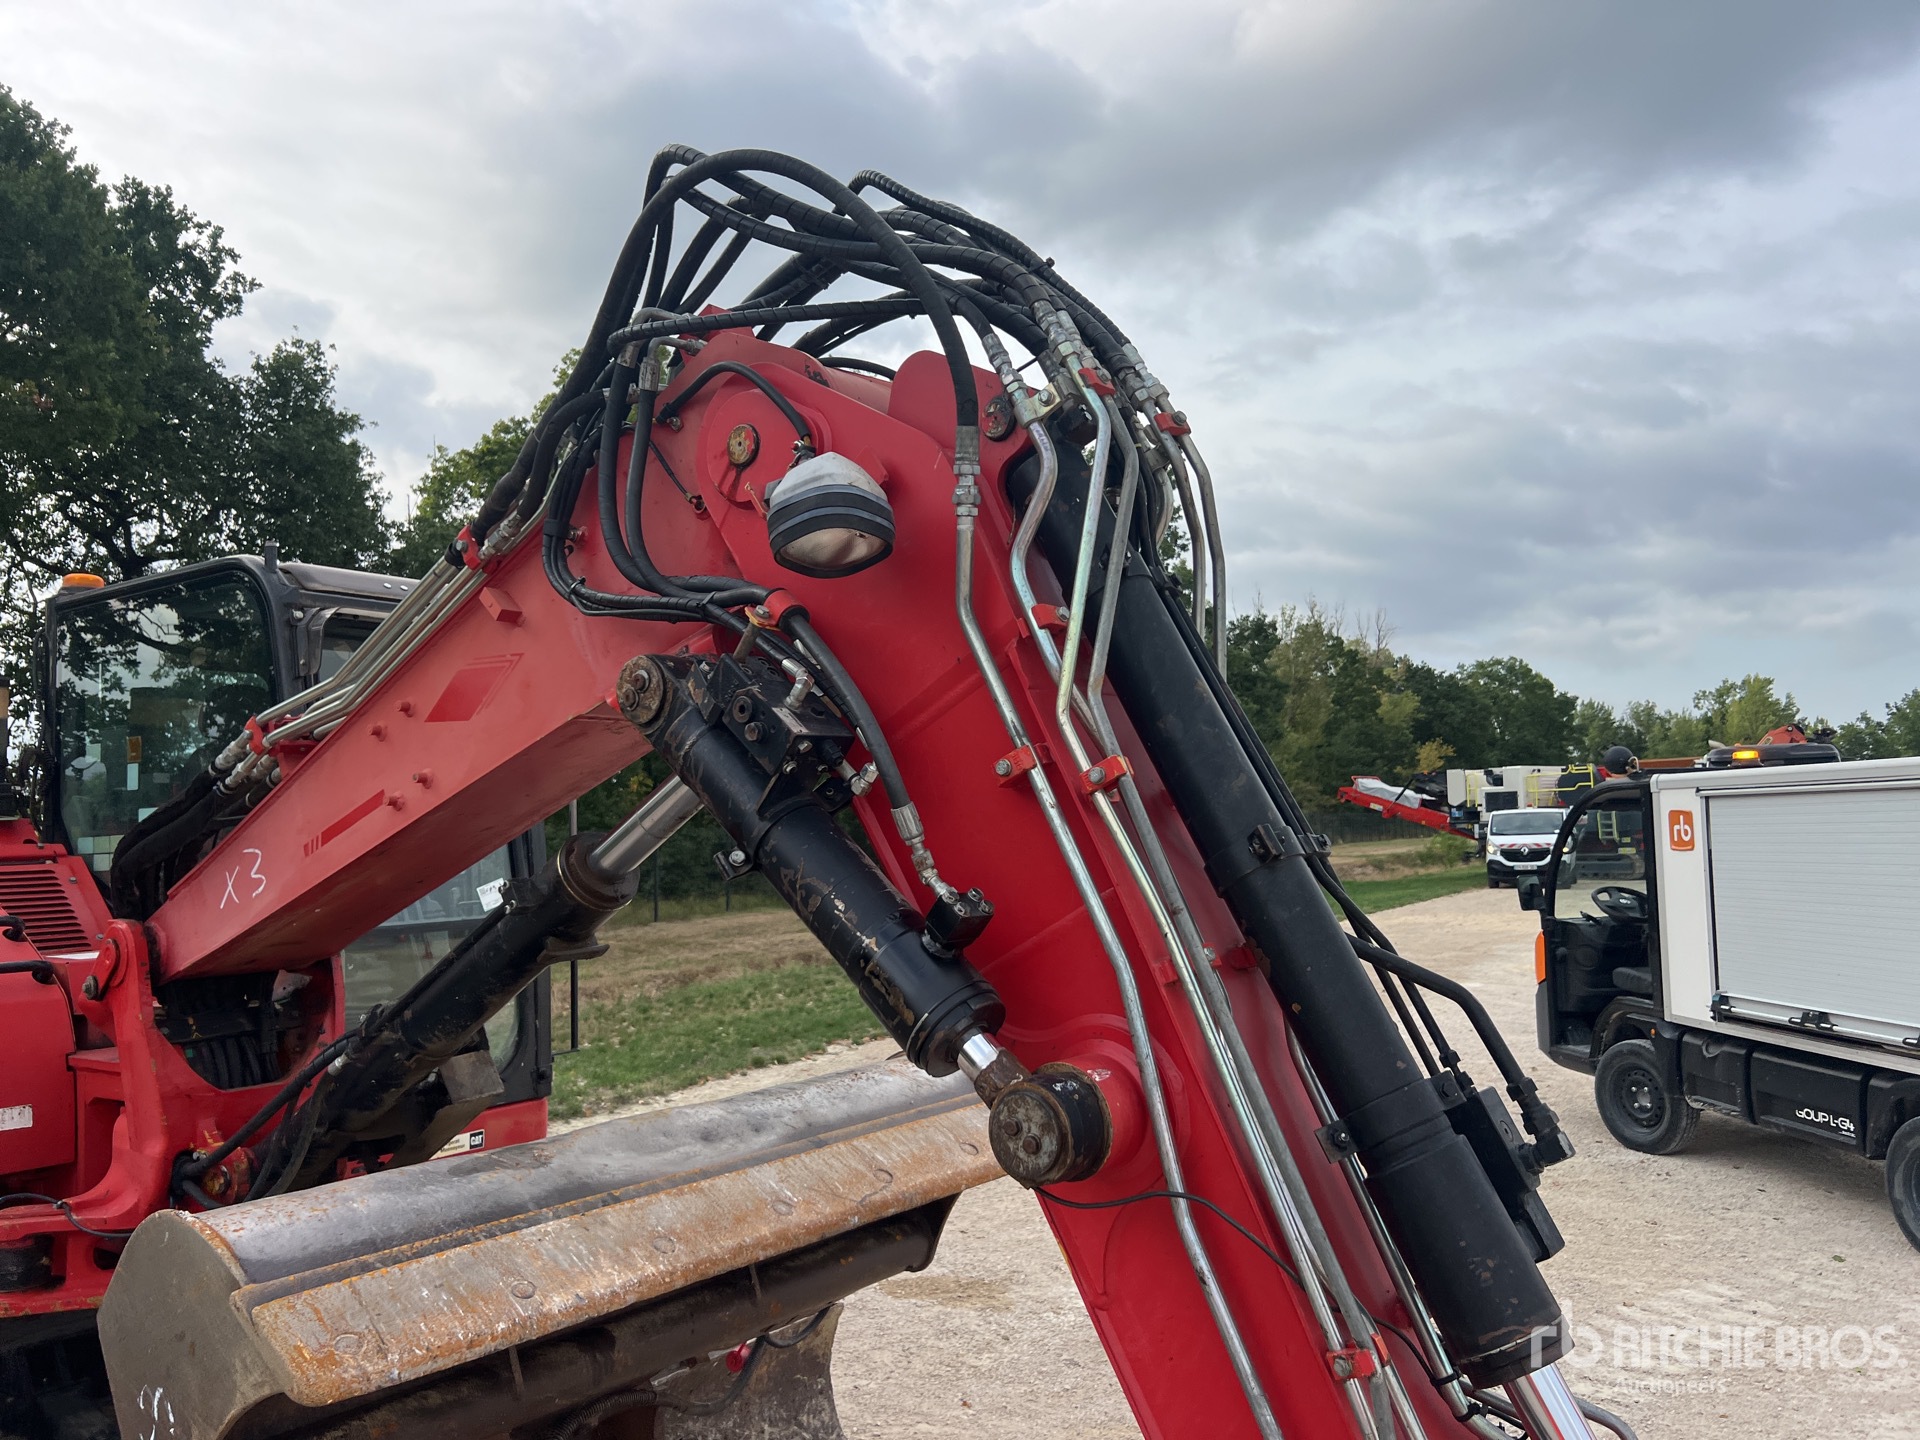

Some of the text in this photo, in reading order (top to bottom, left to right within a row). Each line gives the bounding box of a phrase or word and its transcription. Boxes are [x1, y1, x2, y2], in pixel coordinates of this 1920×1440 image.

[1673, 815, 1692, 842] rb
[220, 848, 267, 909] X3
[470, 1134, 483, 1146] CAT
